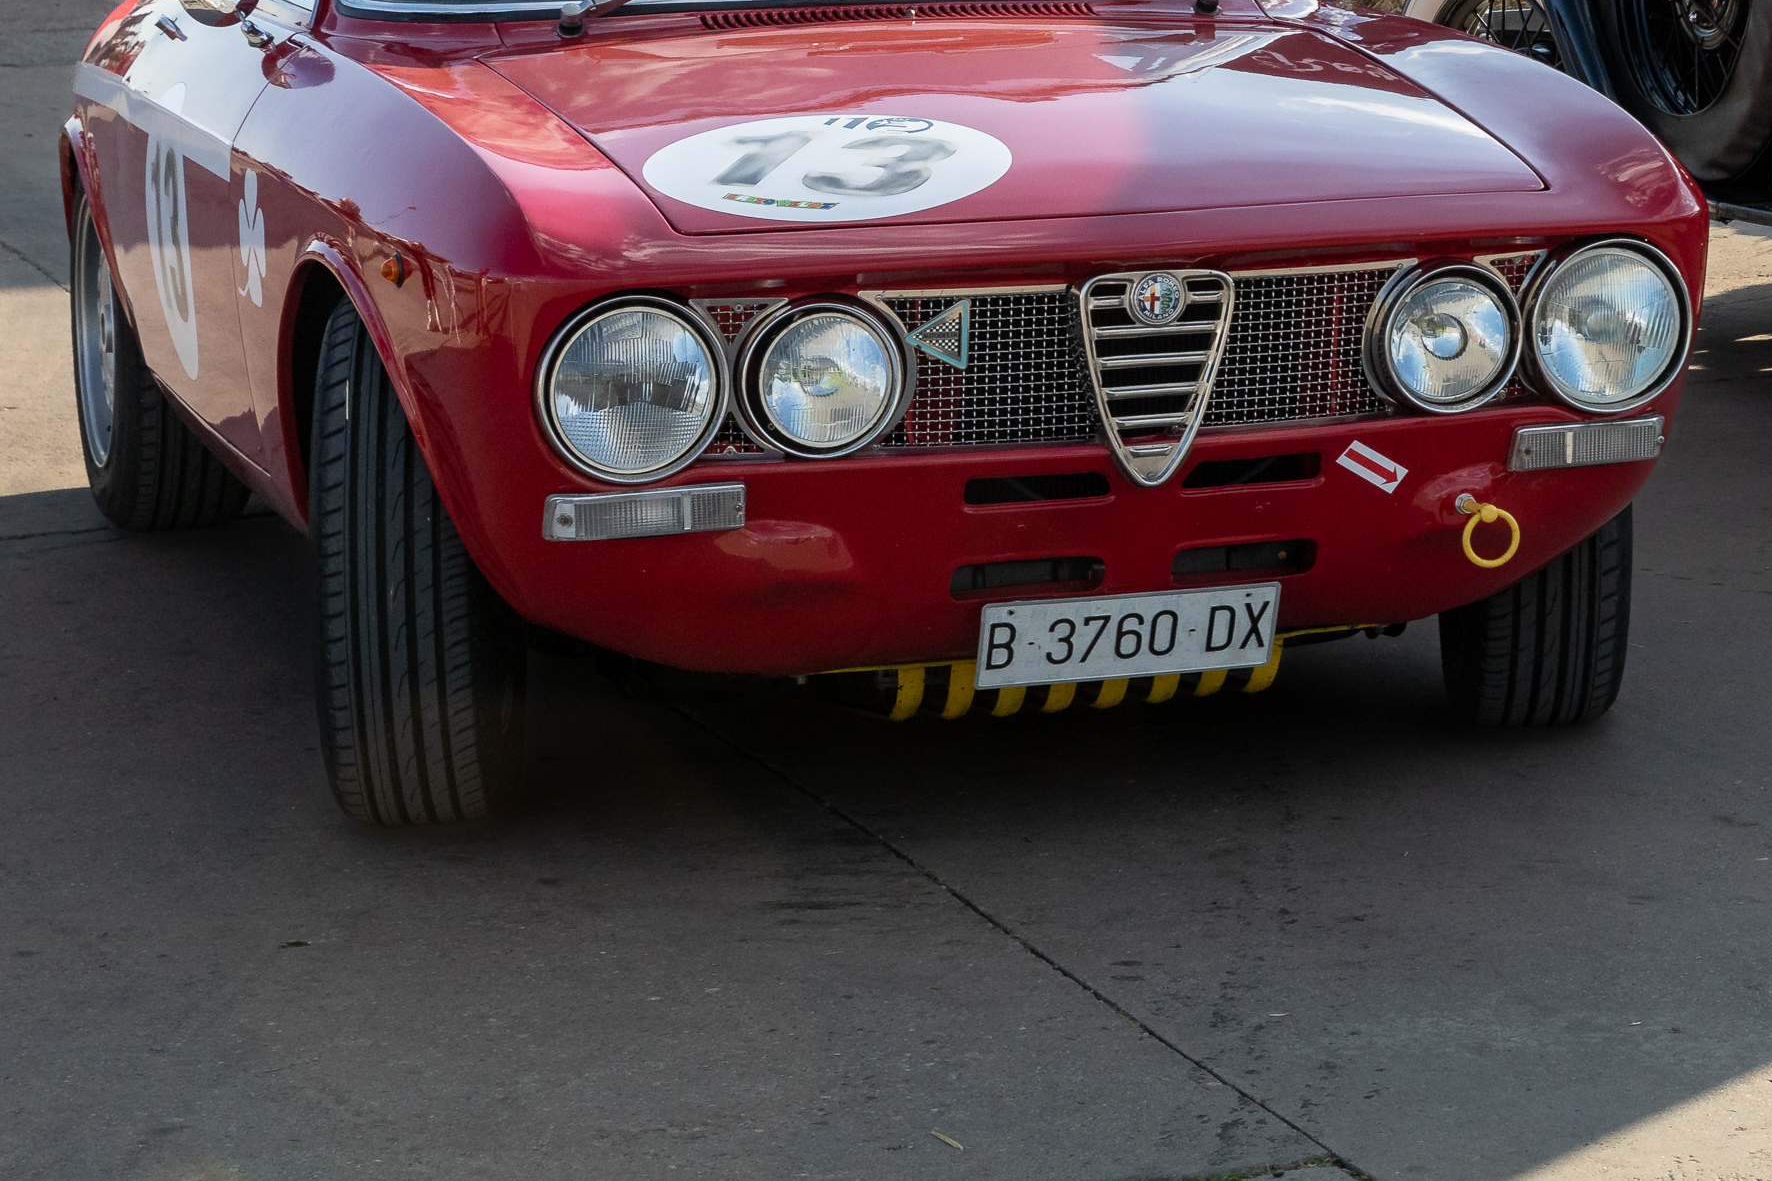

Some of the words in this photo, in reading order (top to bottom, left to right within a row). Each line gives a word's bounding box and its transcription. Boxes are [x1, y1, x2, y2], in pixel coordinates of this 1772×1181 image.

[710, 130, 958, 198] 13
[152, 141, 189, 323] 13
[1138, 279, 1155, 300] ALFA
[1157, 277, 1180, 299] ROMEO
[1143, 309, 1174, 319] MILANO
